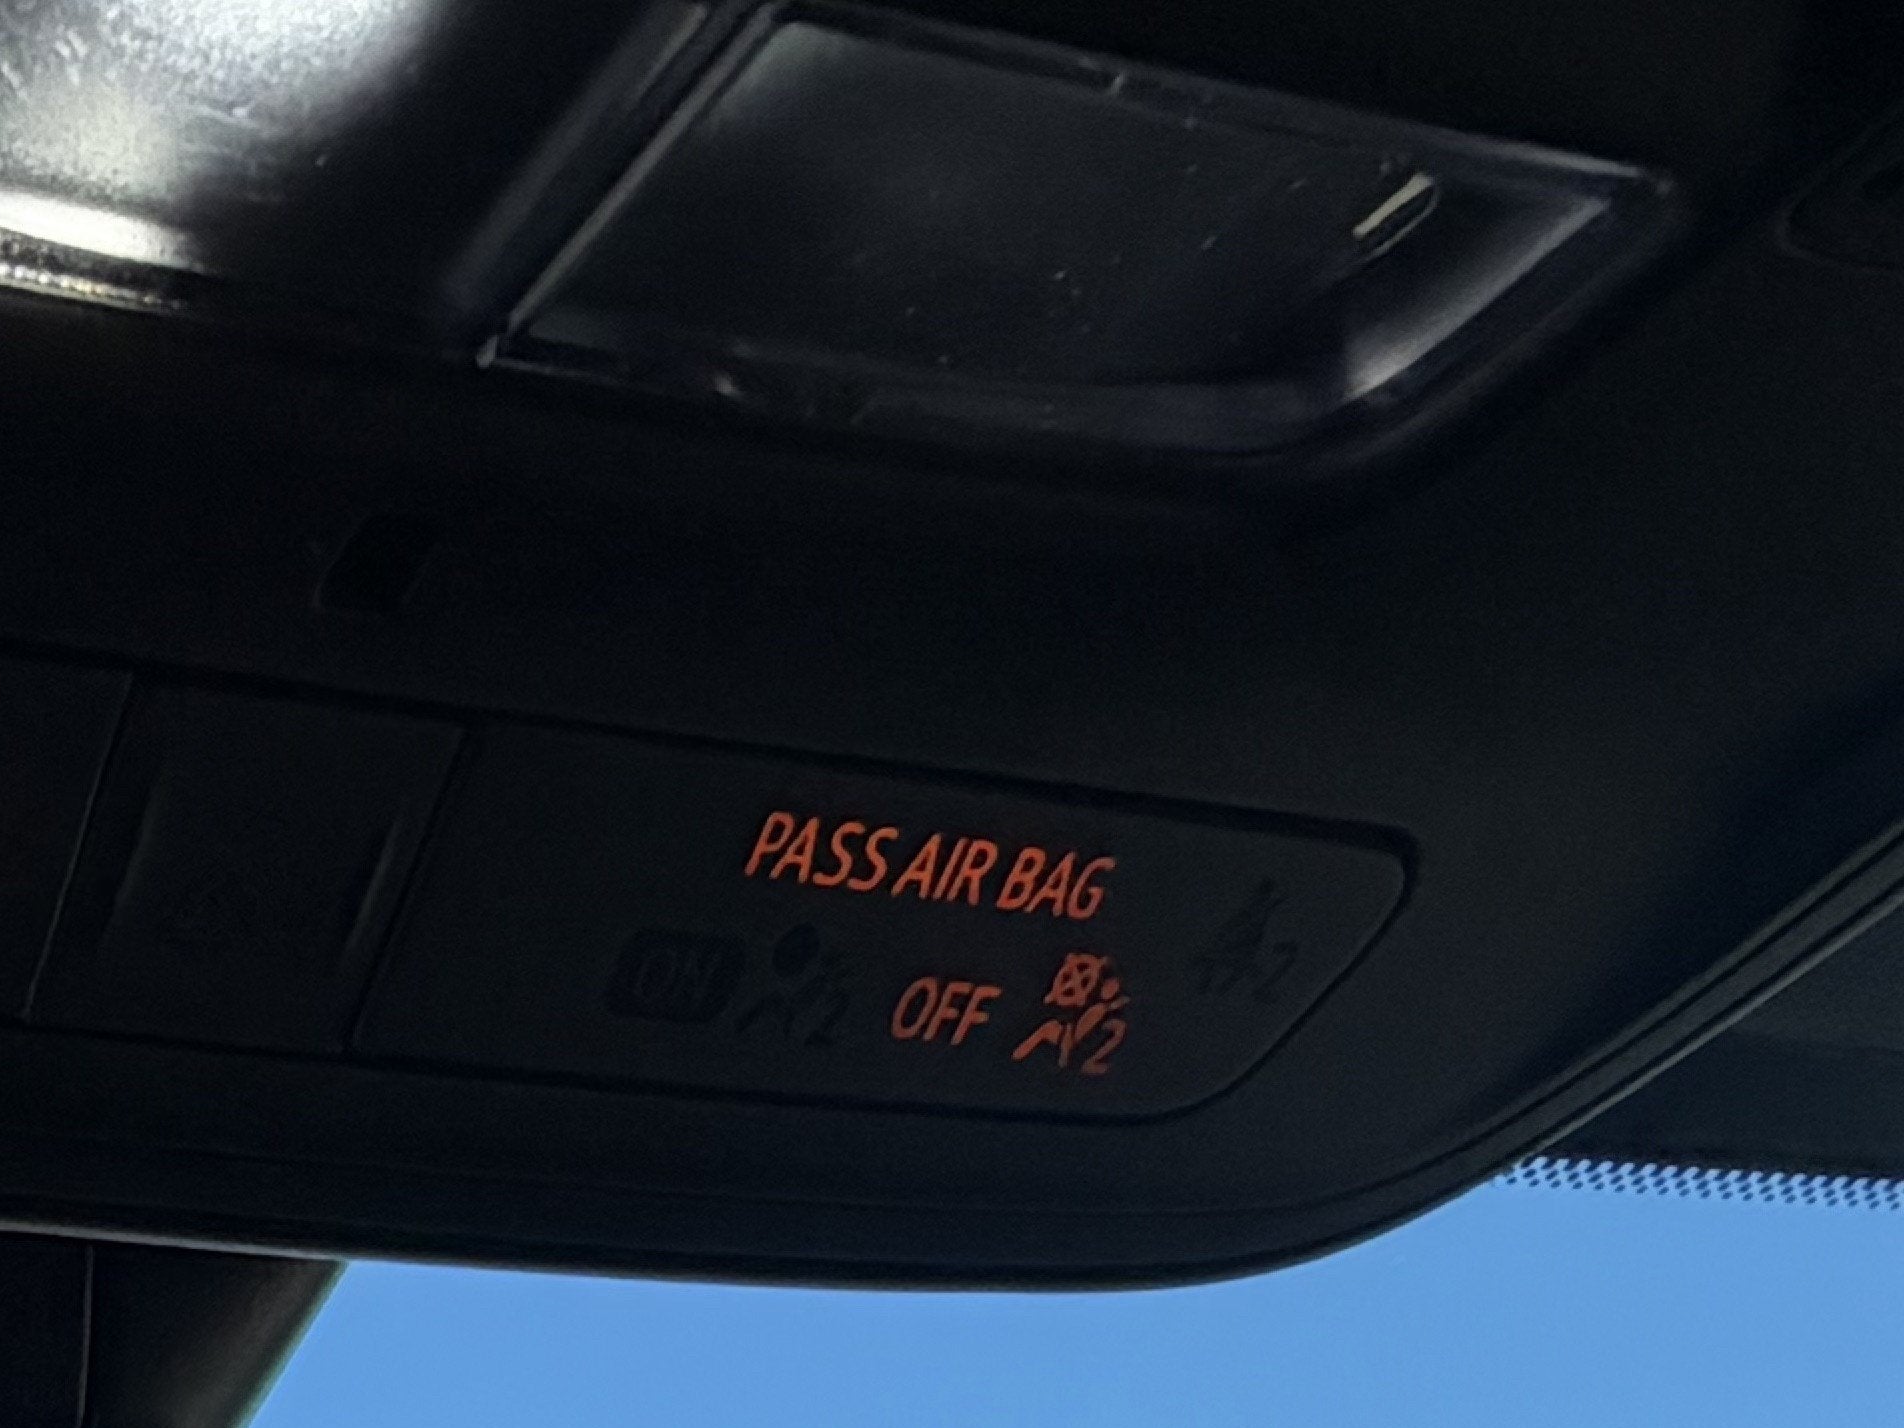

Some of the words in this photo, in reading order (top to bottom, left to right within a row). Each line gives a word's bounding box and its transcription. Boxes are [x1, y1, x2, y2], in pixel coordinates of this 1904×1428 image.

[744, 810, 899, 893] PASS
[891, 832, 998, 905] AIR
[995, 846, 1116, 920] BAG
[891, 976, 1002, 1046] OFF
